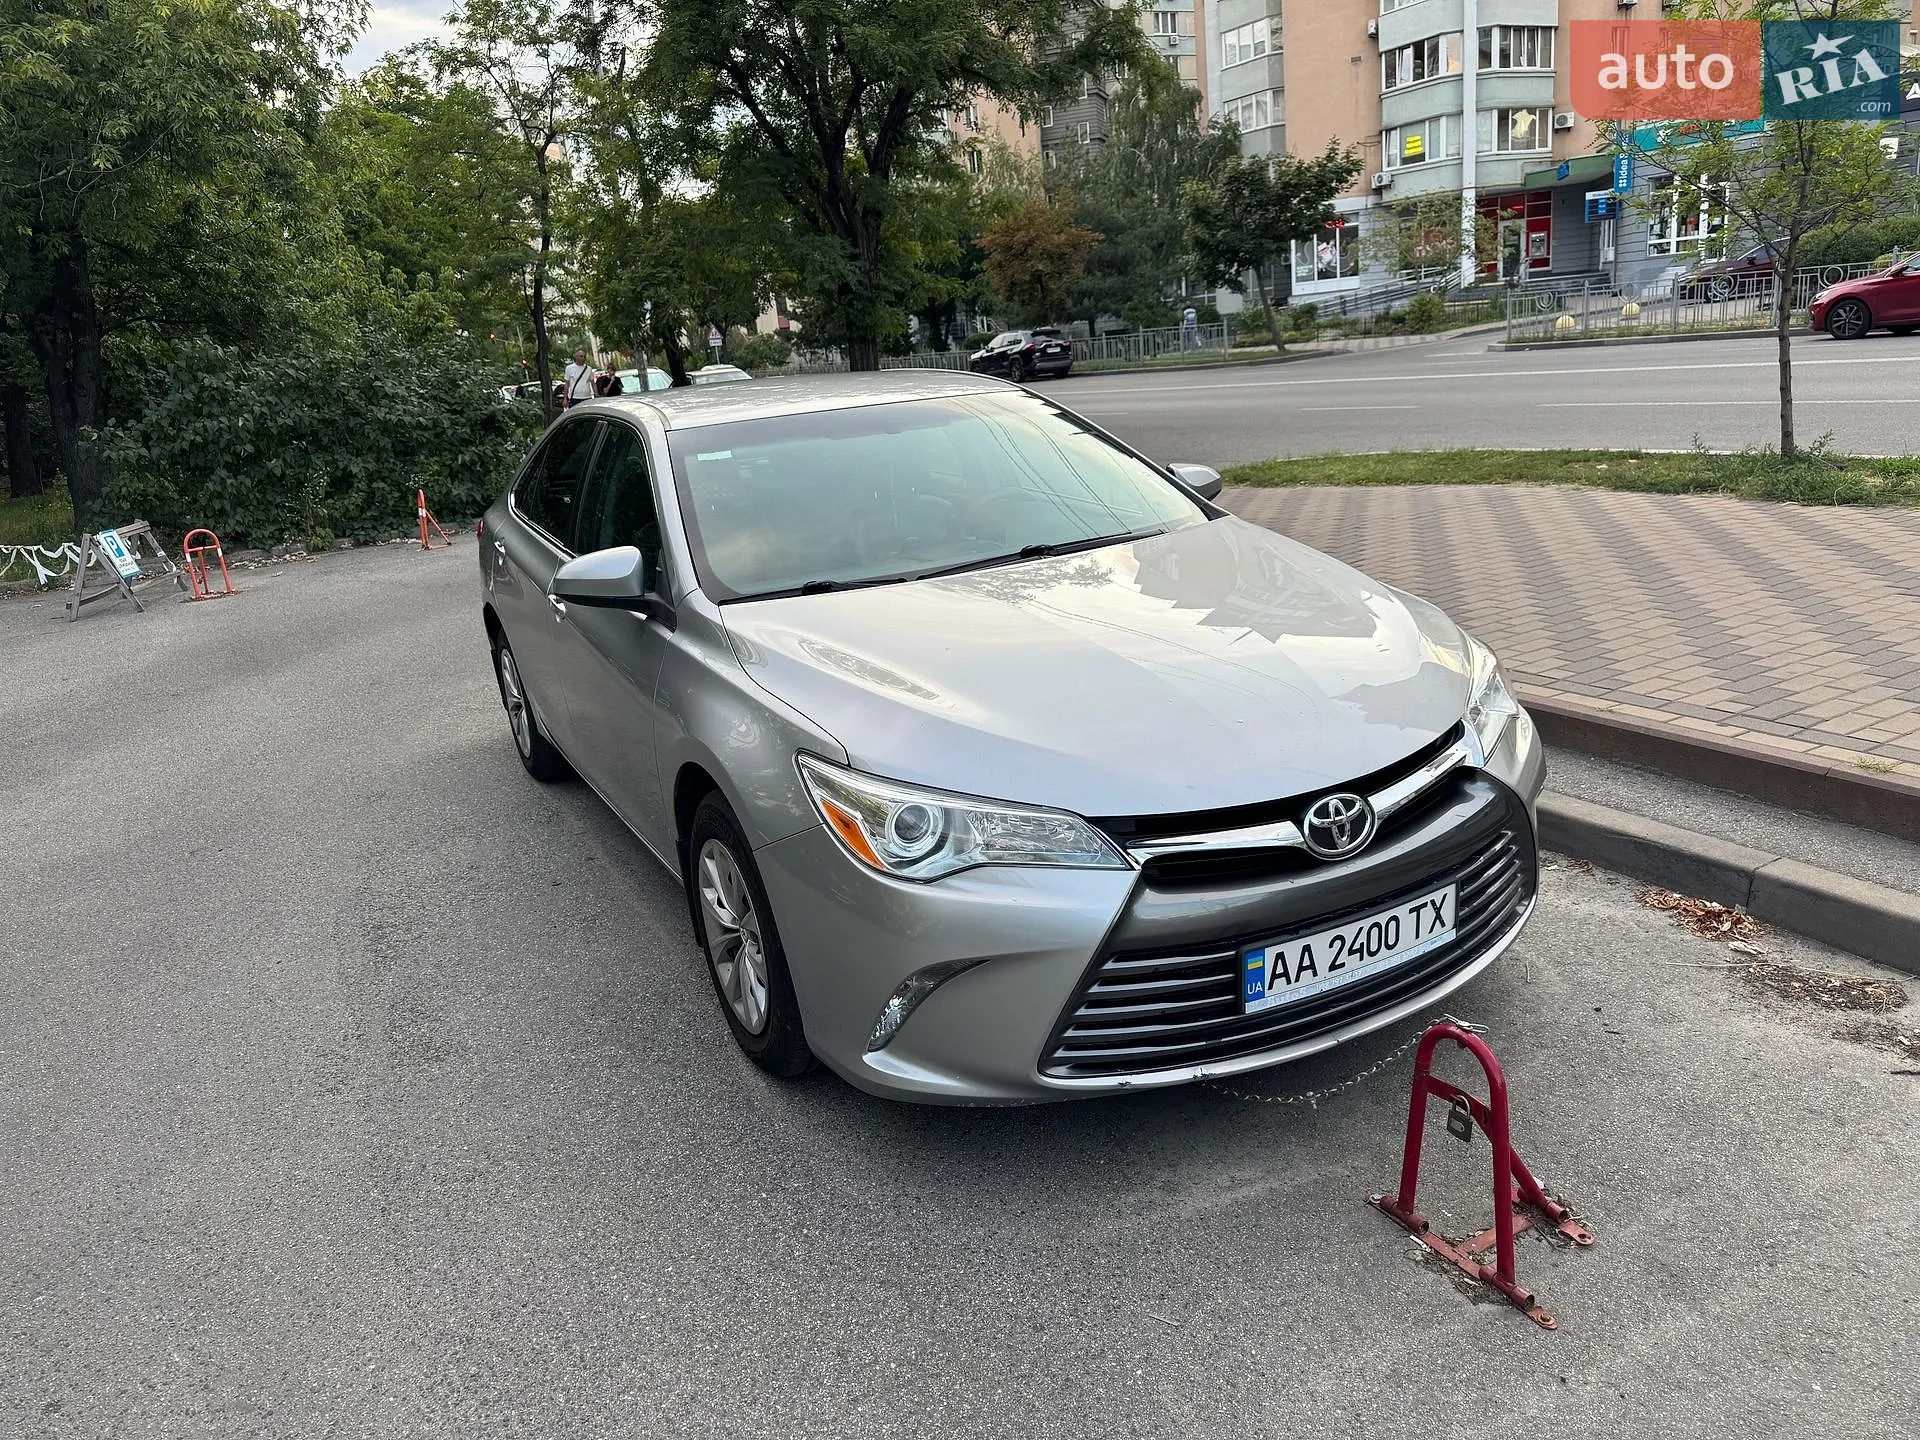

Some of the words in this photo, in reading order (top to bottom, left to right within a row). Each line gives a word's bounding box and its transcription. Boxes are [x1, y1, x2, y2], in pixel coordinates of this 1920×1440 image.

[1267, 944, 1318, 990] AA
[1327, 914, 1400, 973] 2400
[1408, 892, 1448, 940] TX
[1247, 982, 1263, 995] UA
